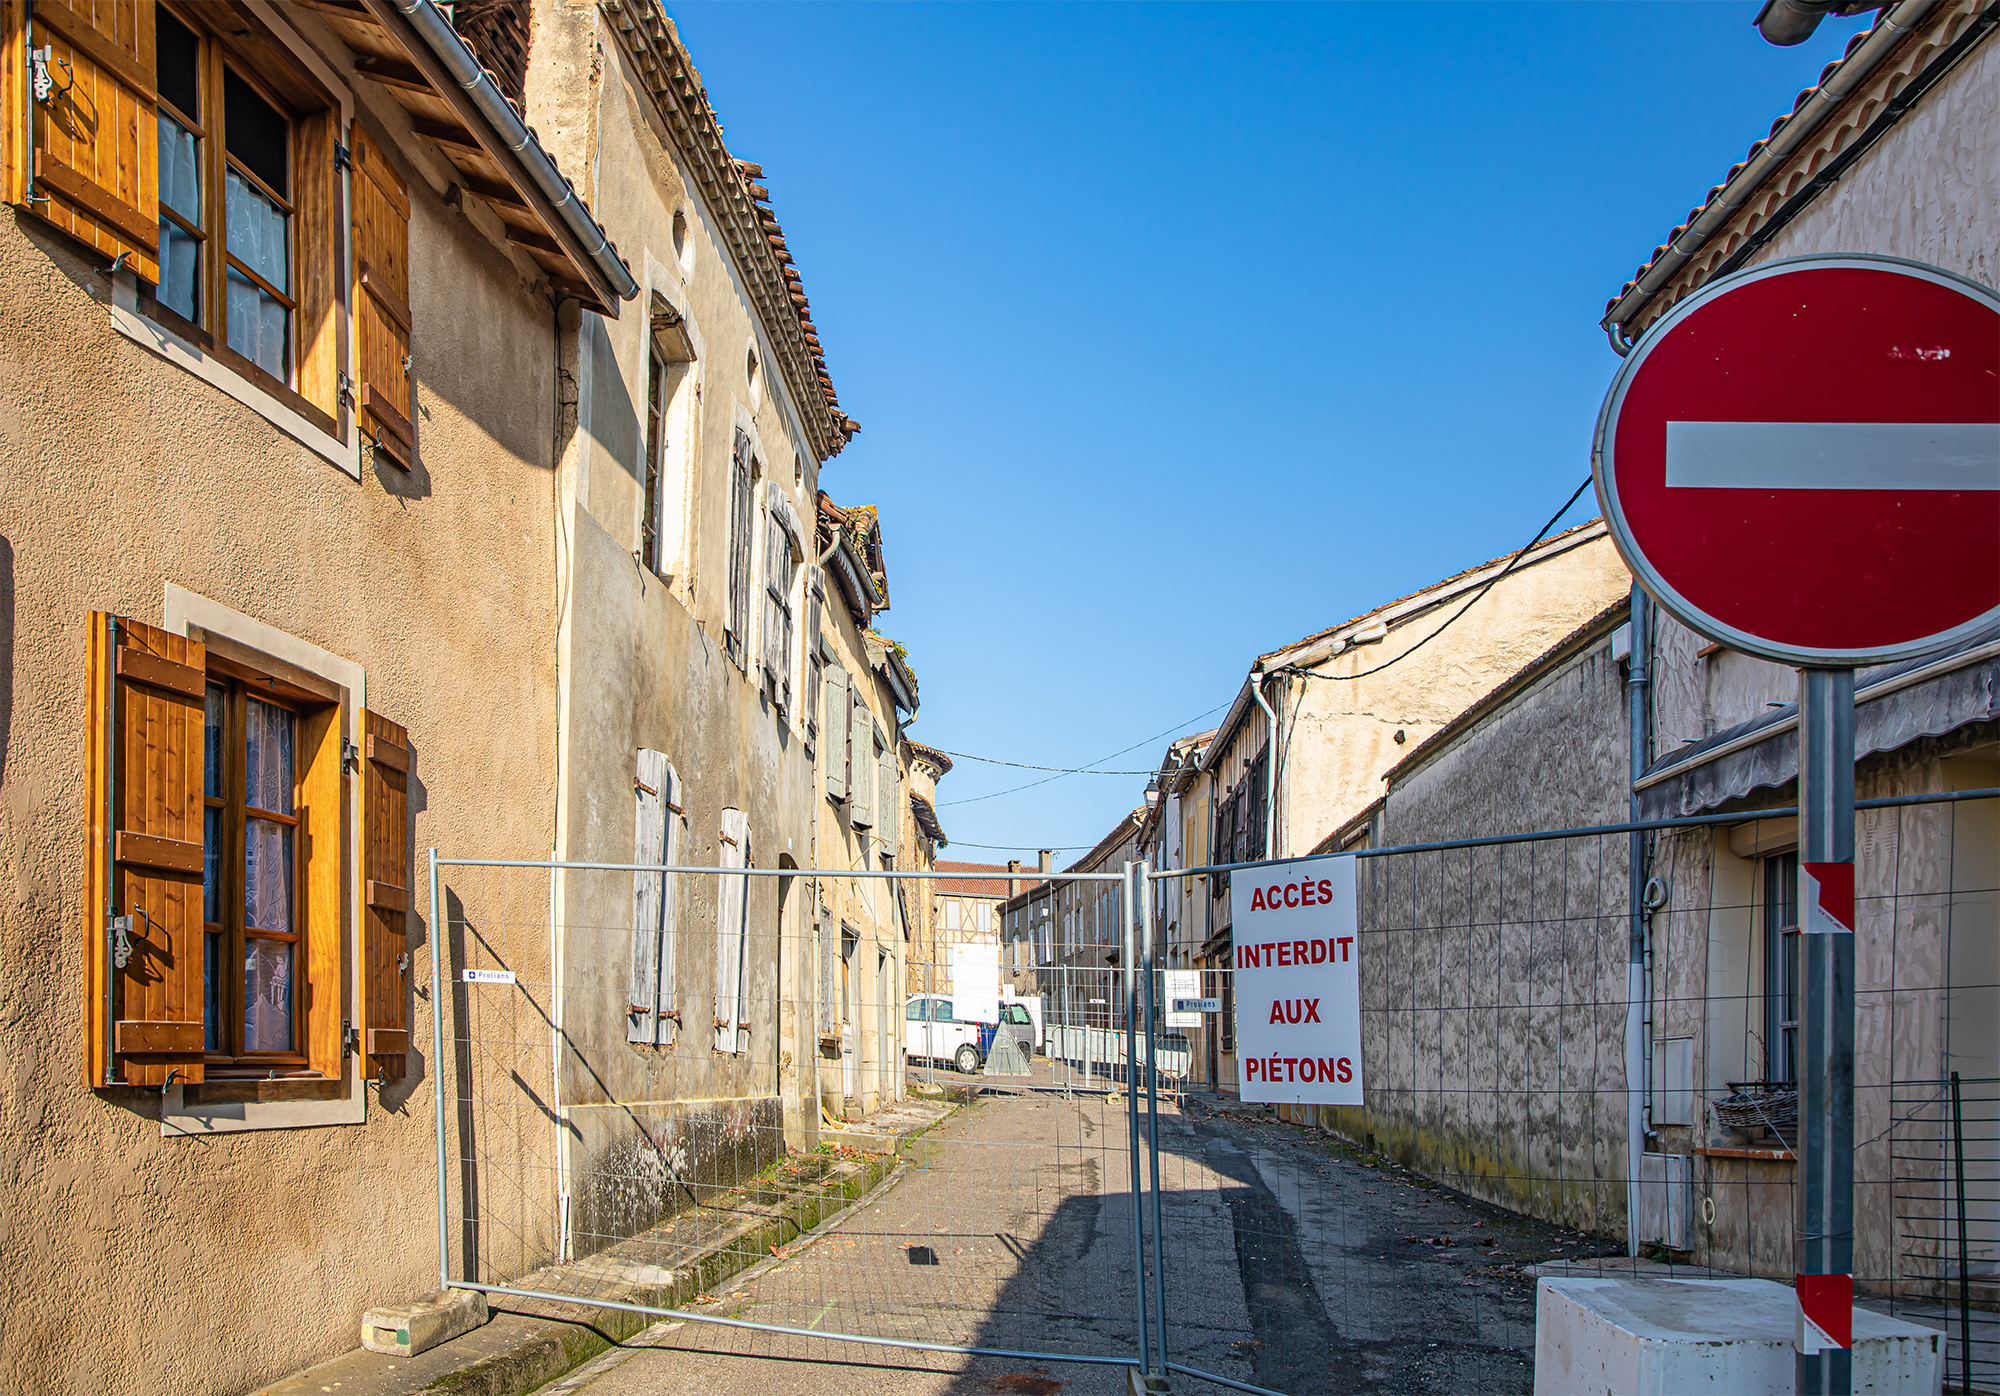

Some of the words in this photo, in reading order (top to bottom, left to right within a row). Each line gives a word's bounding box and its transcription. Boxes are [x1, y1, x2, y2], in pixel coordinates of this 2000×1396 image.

[1250, 875, 1333, 912] ACCÈS
[1237, 936, 1353, 969] INTERDIT
[478, 971, 509, 979] Prolians
[1269, 998, 1321, 1024] AUX
[1245, 1051, 1353, 1083] PIÉTONS
